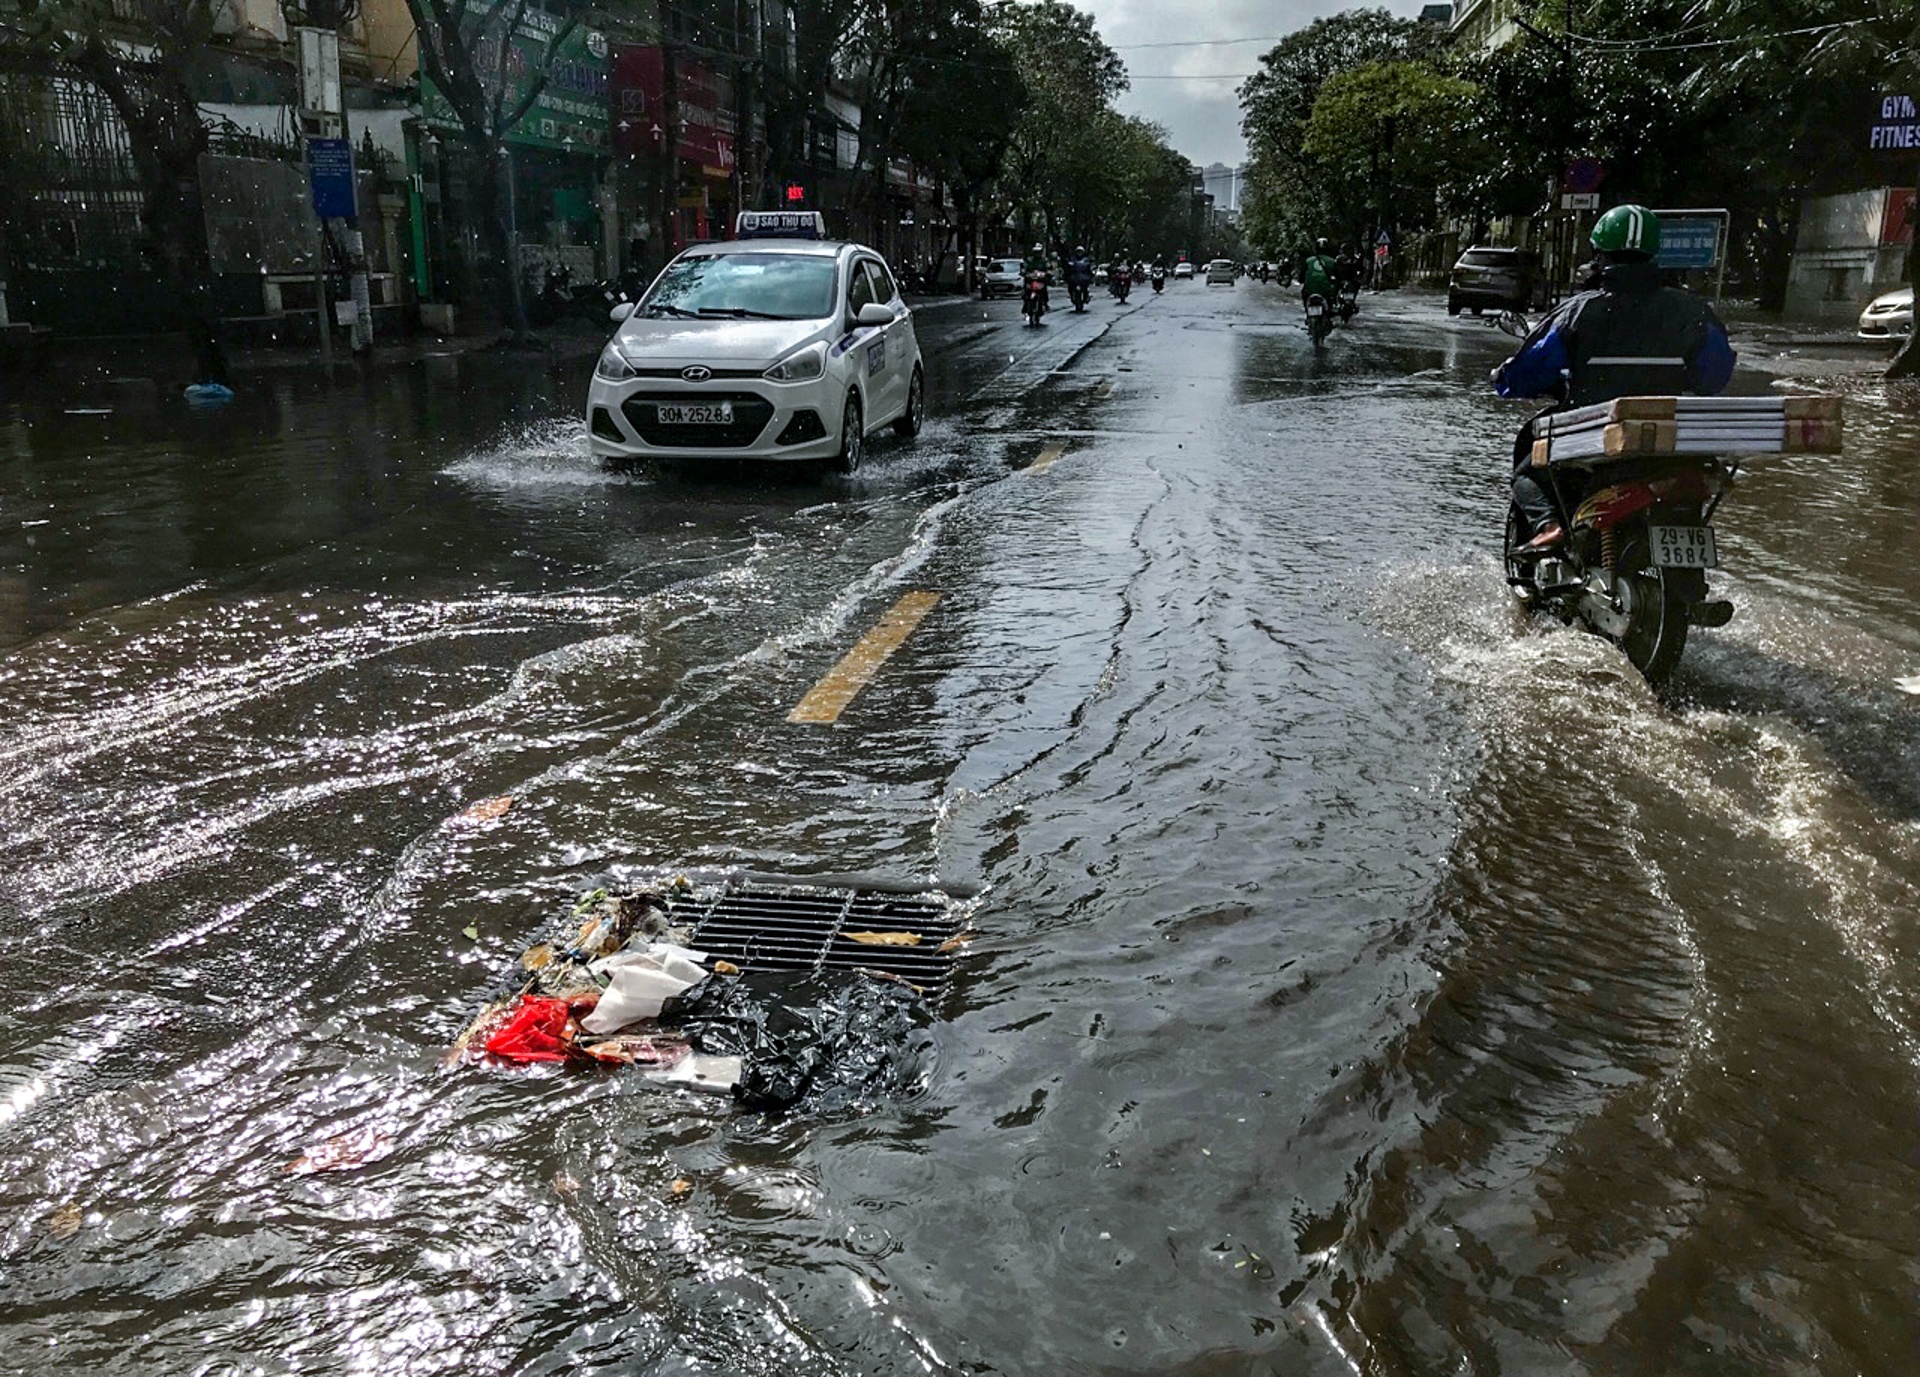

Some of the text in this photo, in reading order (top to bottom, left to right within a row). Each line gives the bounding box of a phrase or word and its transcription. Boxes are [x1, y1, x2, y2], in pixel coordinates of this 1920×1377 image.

[1882, 95, 1916, 119] GYM
[761, 215, 779, 227] SAO
[1661, 547, 1708, 564] 3684
